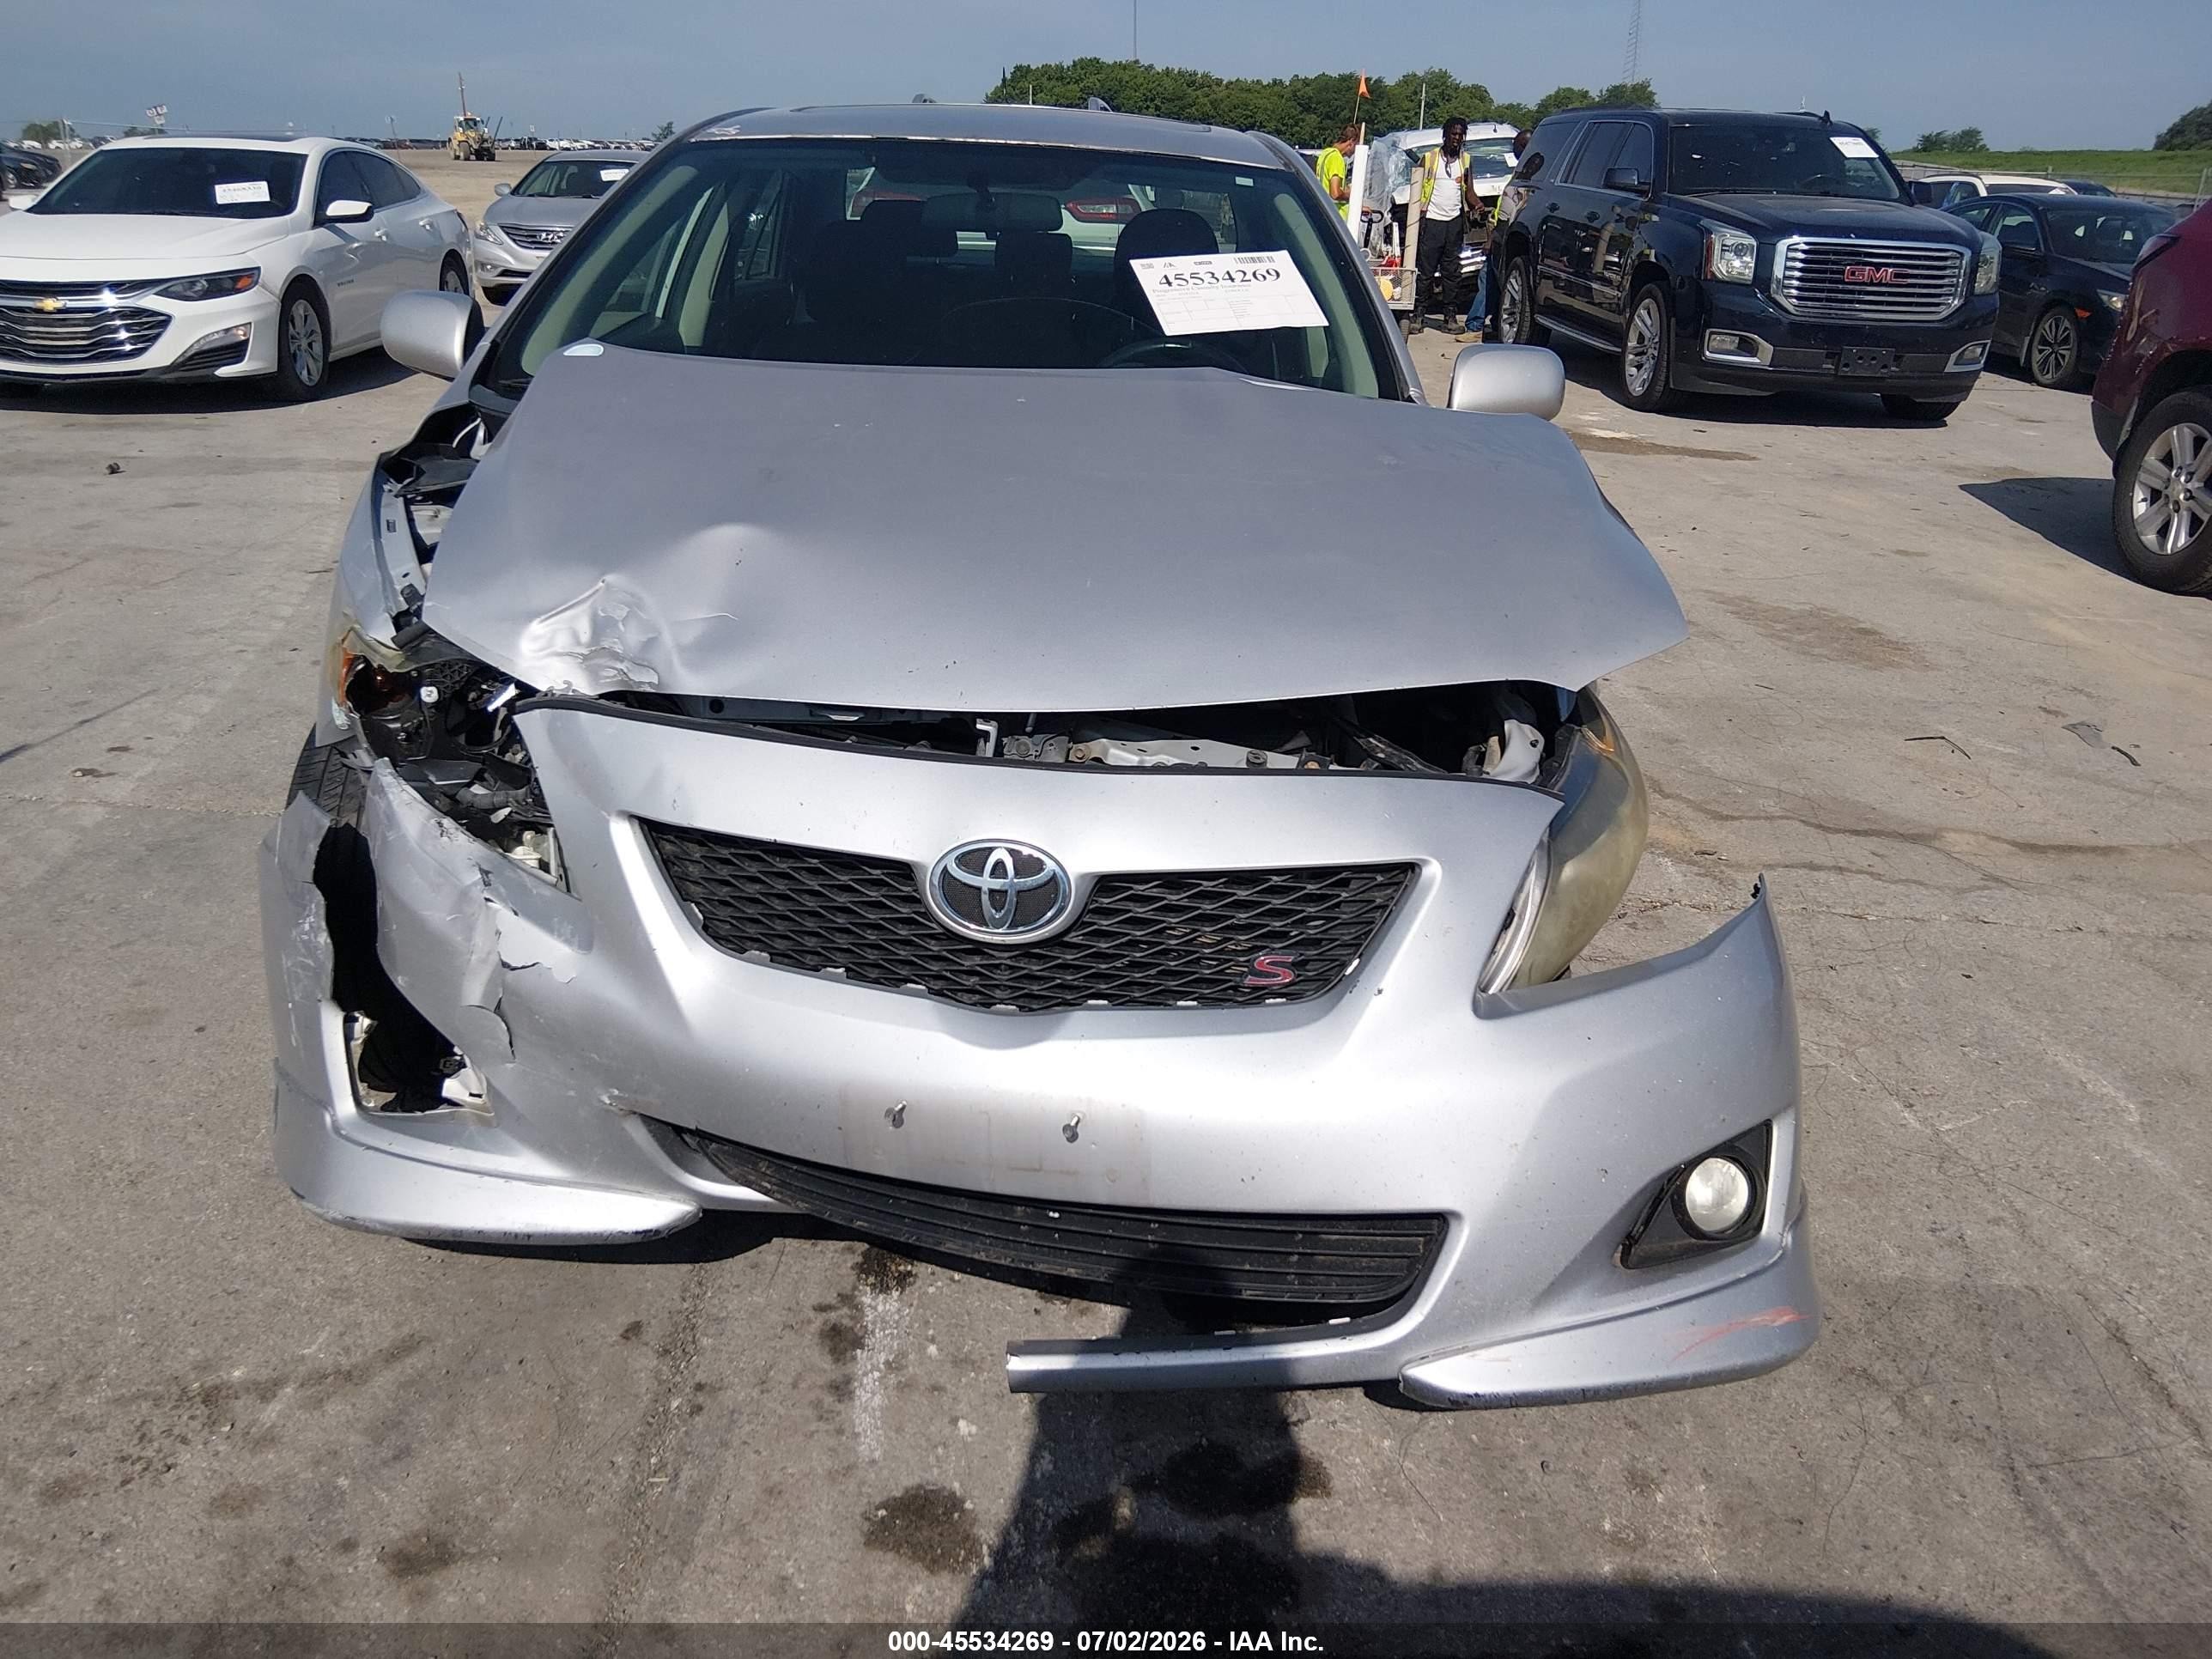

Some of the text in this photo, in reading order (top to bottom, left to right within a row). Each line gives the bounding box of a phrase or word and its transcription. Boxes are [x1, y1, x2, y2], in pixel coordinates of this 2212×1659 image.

[1158, 267, 1281, 288] 45534269
[1844, 265, 1910, 284] GMC
[1243, 955, 1294, 985] S
